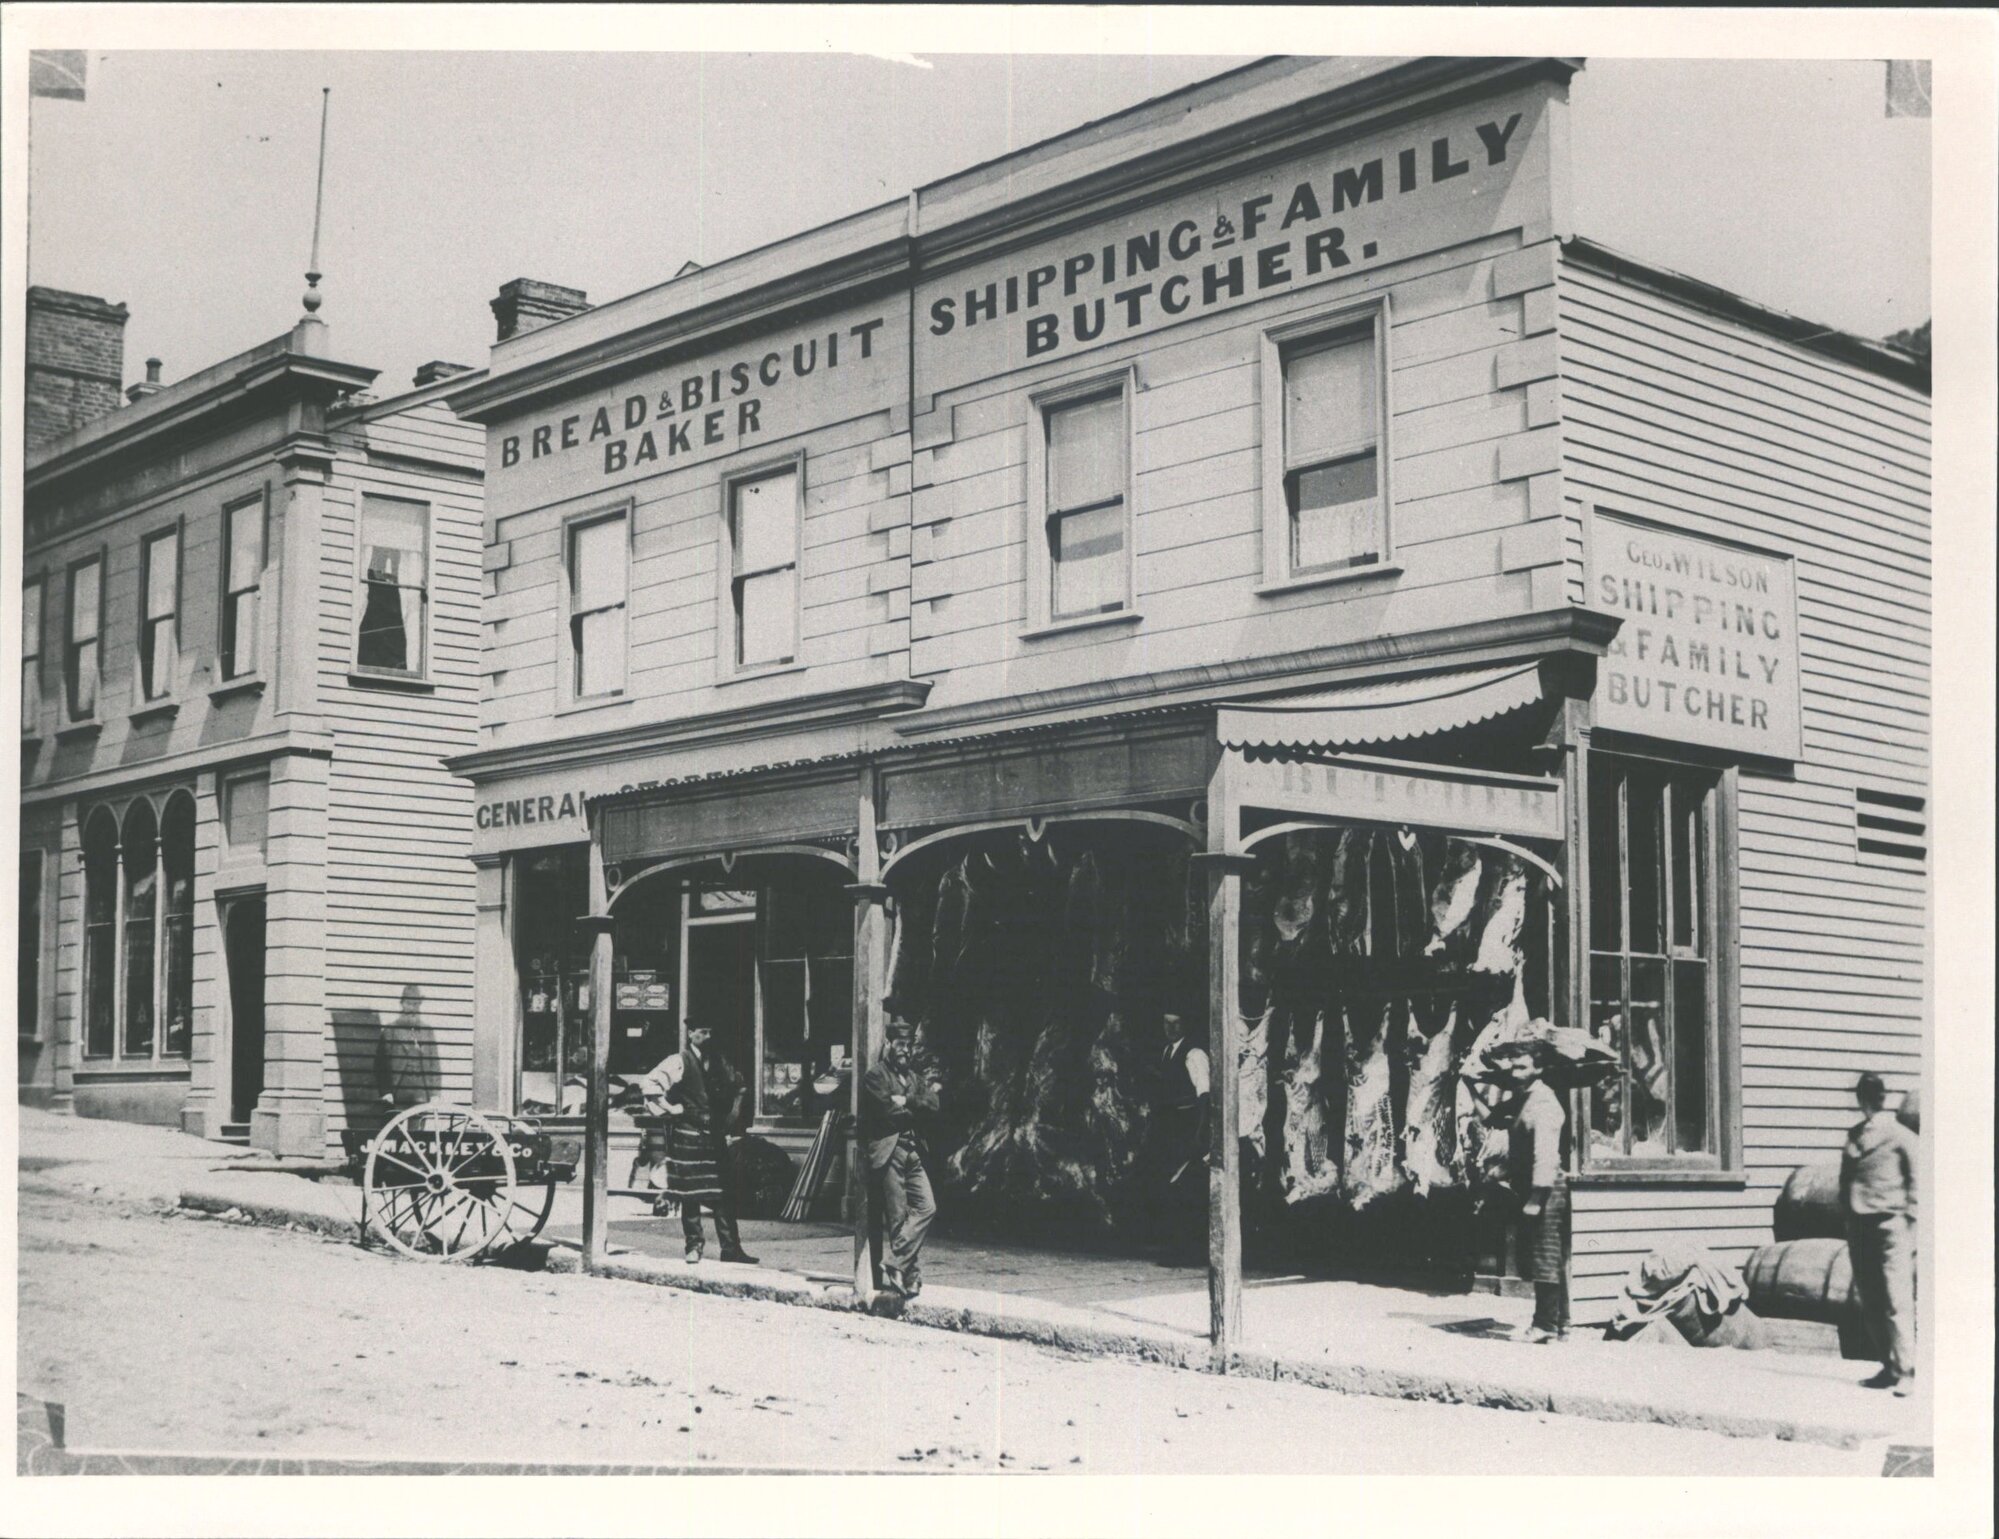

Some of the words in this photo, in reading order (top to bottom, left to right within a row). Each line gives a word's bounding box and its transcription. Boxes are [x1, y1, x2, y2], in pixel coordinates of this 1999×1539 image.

[930, 218, 1199, 337] SHIPPING
[1213, 213, 1235, 249] &
[1241, 113, 1523, 242] FAMILY
[1026, 225, 1379, 359] BUTCHER.
[502, 394, 648, 469] BREAD
[656, 390, 676, 420] &
[681, 317, 885, 413] BISCUIT
[603, 398, 762, 475] BAKER
[1600, 574, 1780, 640] SHIPPING
[1673, 552, 1768, 594] WILSON
[1636, 628, 1779, 684] FAMILY
[1607, 671, 1768, 730] BUTCHER
